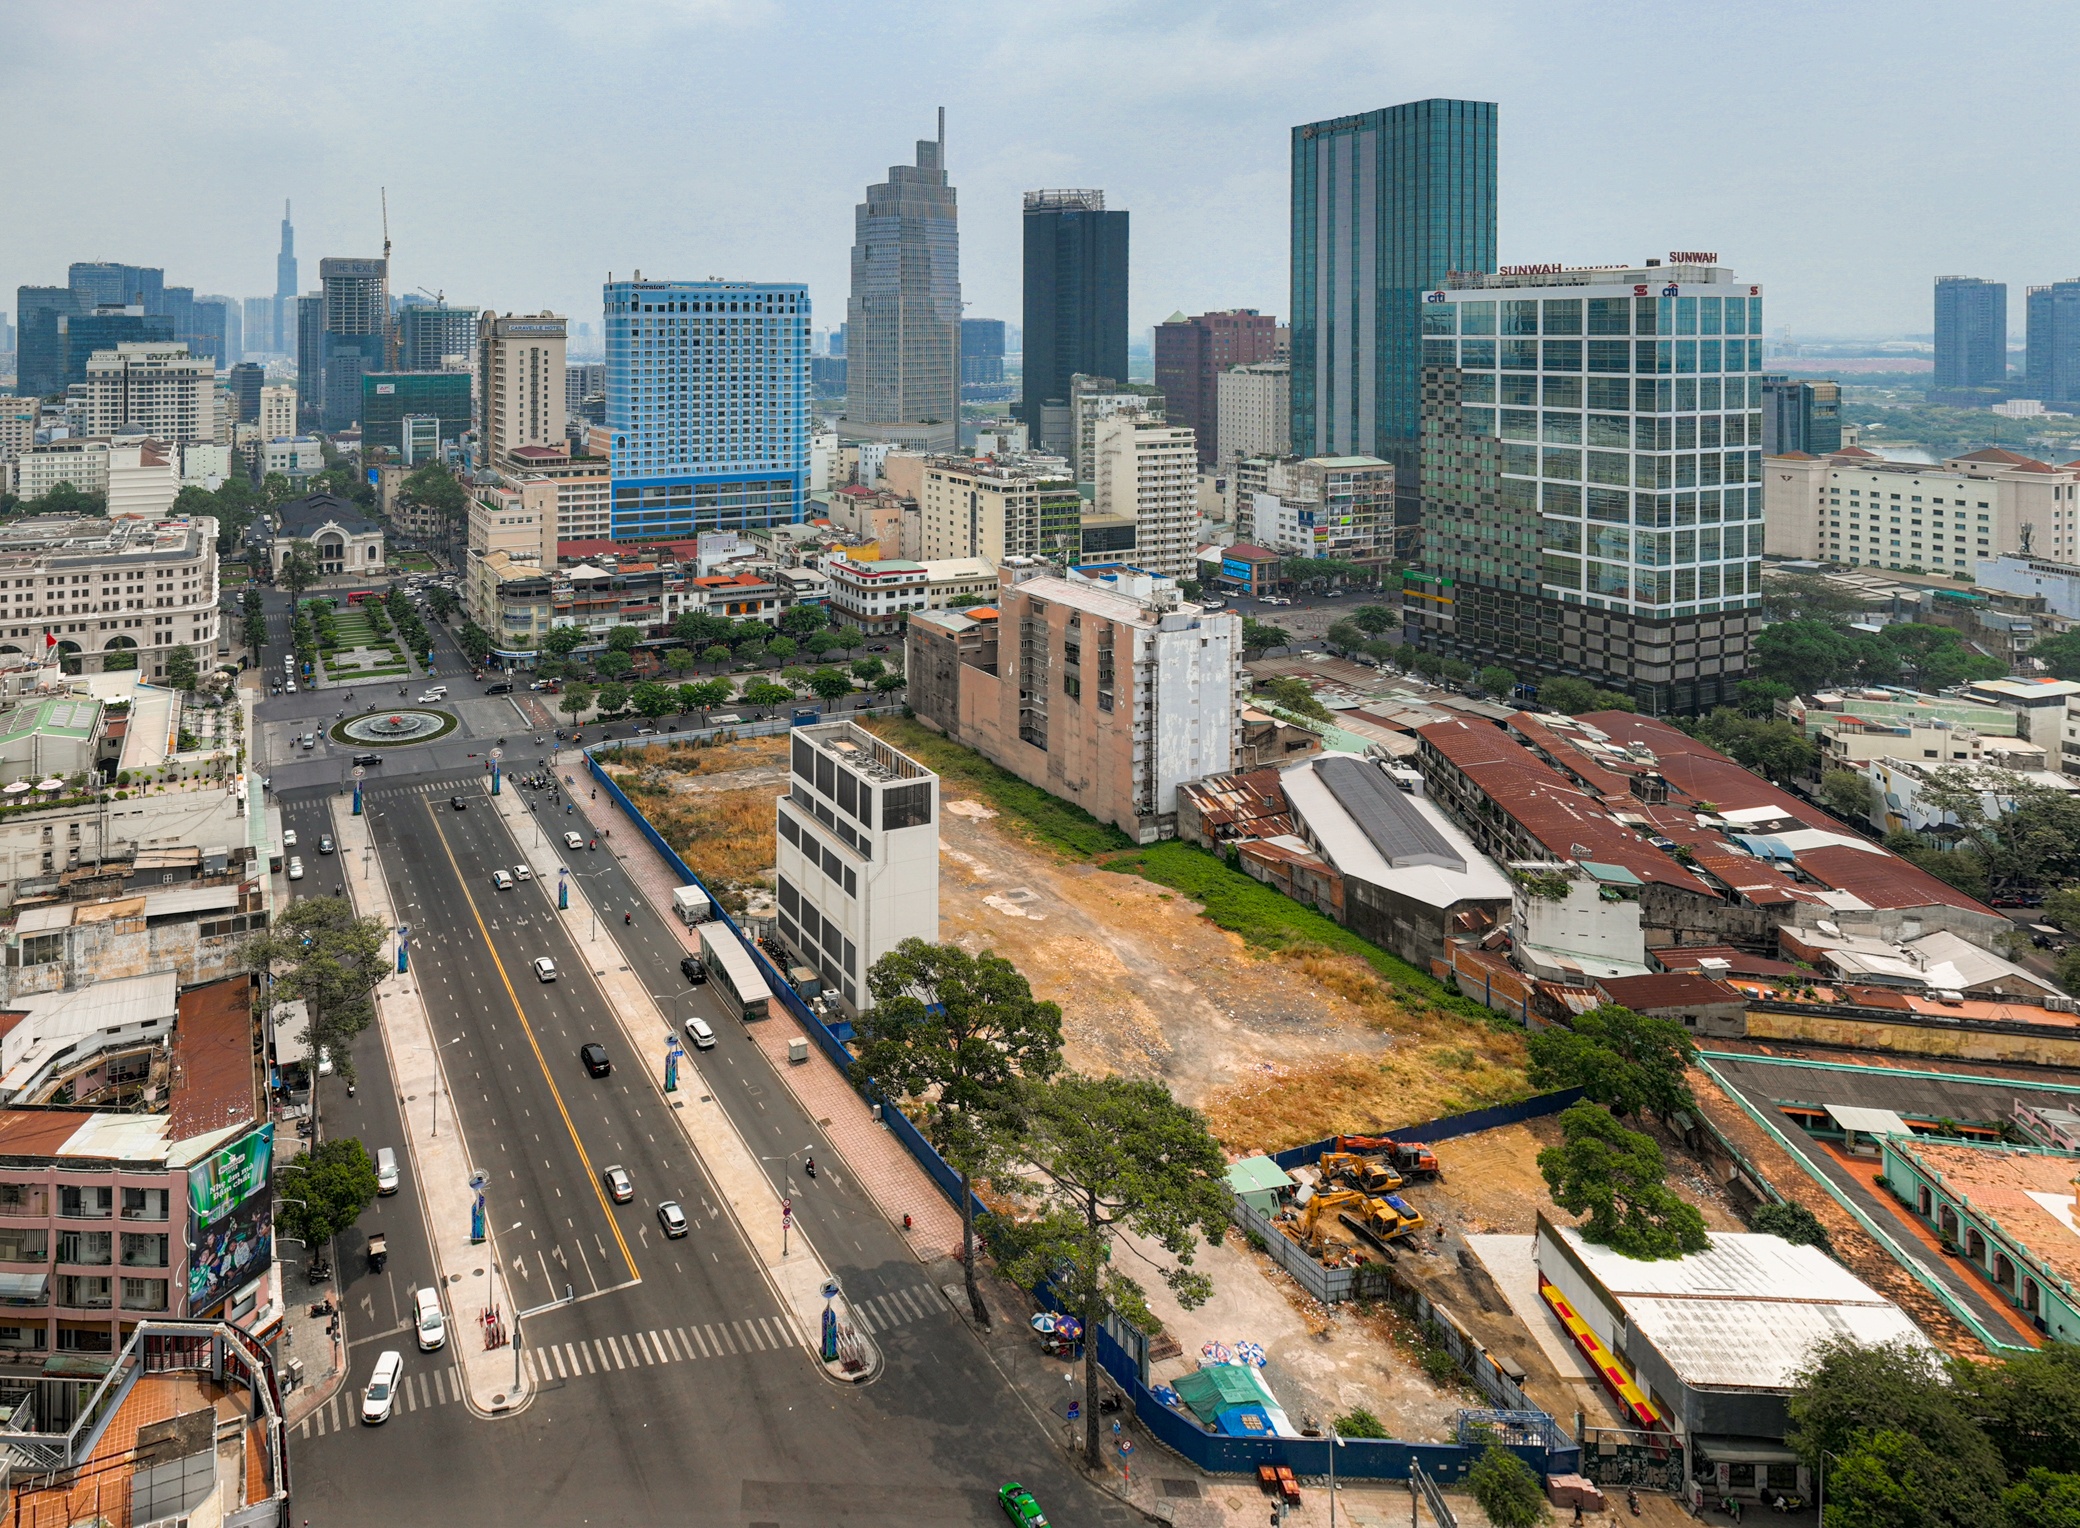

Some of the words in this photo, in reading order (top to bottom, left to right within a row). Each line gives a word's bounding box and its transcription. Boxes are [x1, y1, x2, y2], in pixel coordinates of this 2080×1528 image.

[1669, 251, 1718, 263] SUNWAH
[335, 263, 348, 273] THE
[352, 263, 379, 273] NEXUS
[1499, 263, 1562, 276] SUNWAH
[1427, 290, 1446, 303] citi
[1662, 283, 1679, 297] citi
[1910, 803, 1930, 818] ITALY
[210, 1181, 226, 1195] Nhẹ
[228, 1172, 240, 1183] êm
[241, 1162, 254, 1175] mà
[213, 1185, 232, 1200] Đậm
